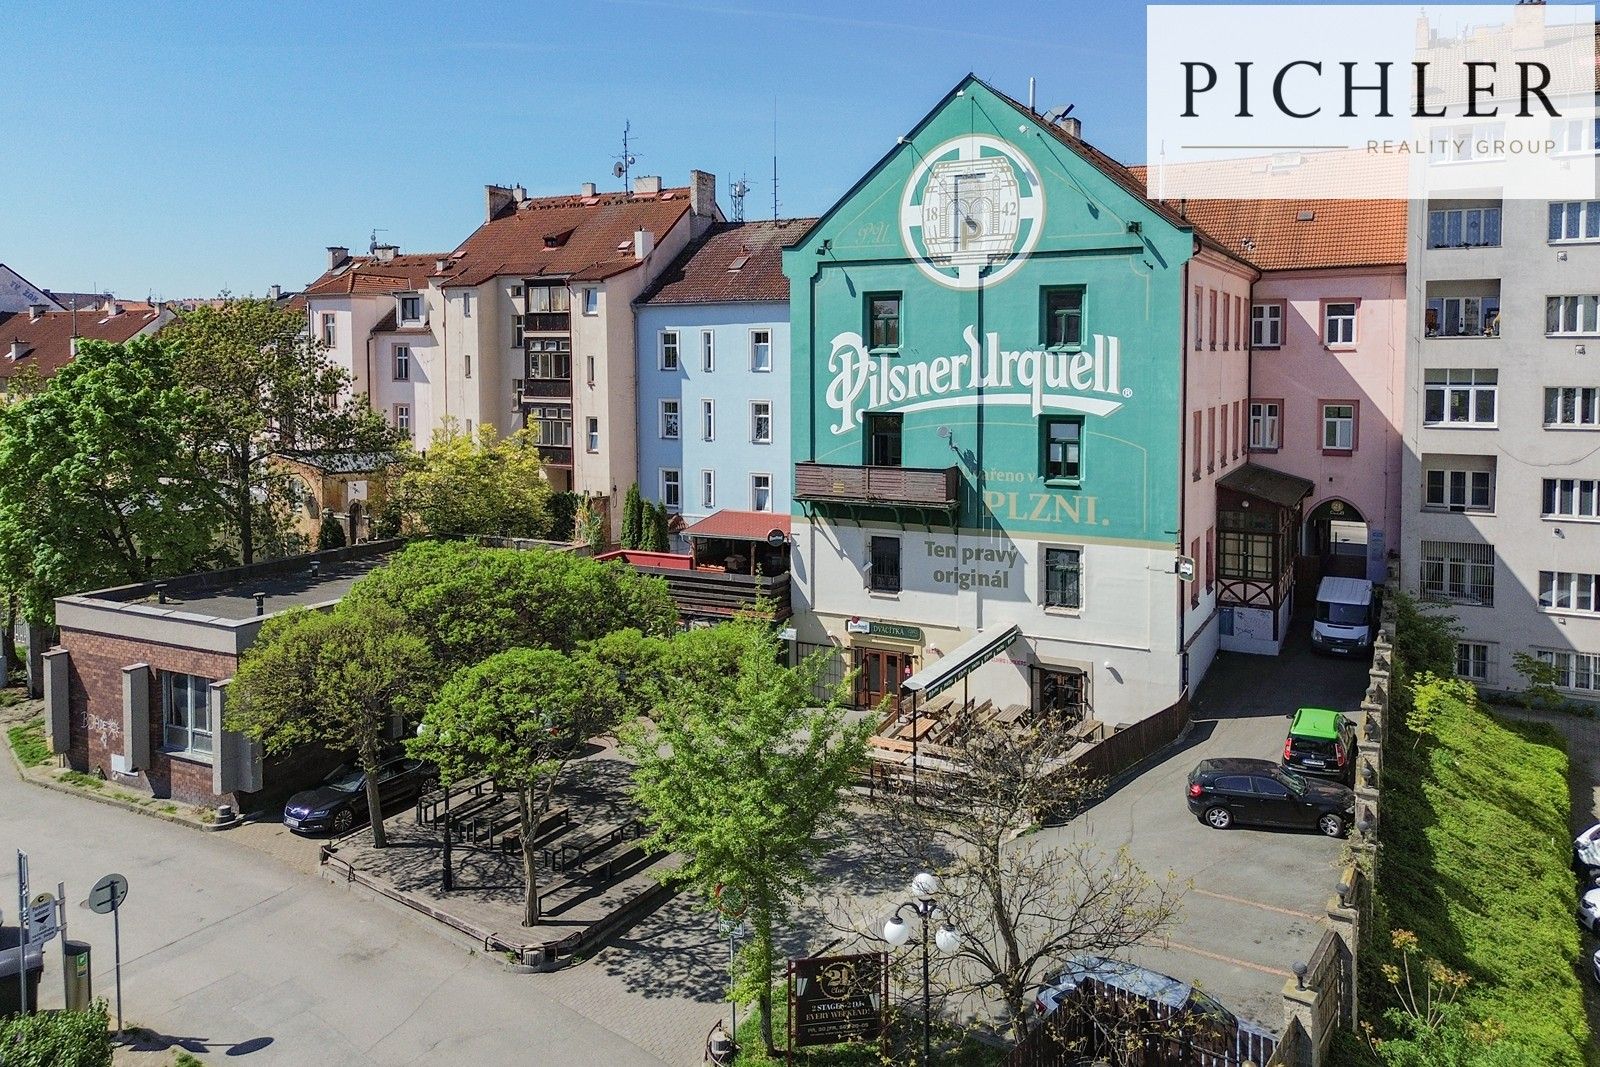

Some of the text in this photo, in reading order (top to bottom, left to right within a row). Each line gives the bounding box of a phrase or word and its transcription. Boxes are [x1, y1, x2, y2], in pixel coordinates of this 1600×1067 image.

[926, 202, 1017, 221] 18 42
[826, 324, 1121, 436] Pilsner Urquell
[982, 490, 1111, 527] PLZNI.
[924, 540, 1019, 569] Ten pravý
[933, 567, 1009, 591] originál
